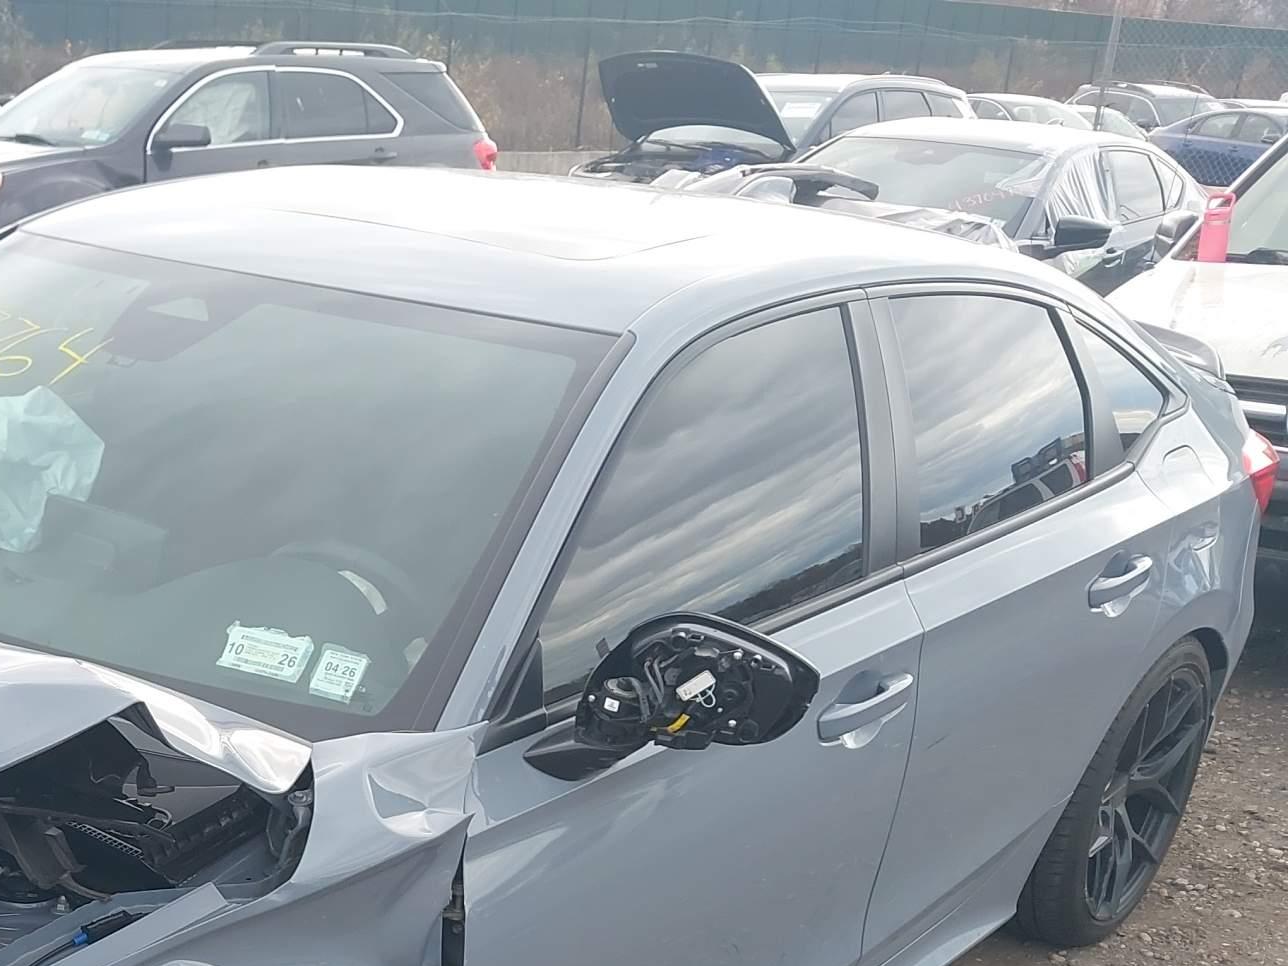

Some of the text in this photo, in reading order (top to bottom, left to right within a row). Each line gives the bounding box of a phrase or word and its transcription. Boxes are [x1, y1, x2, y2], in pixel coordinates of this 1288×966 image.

[227, 642, 245, 656] 10
[277, 653, 298, 668] 26
[324, 661, 358, 678] 04 26
